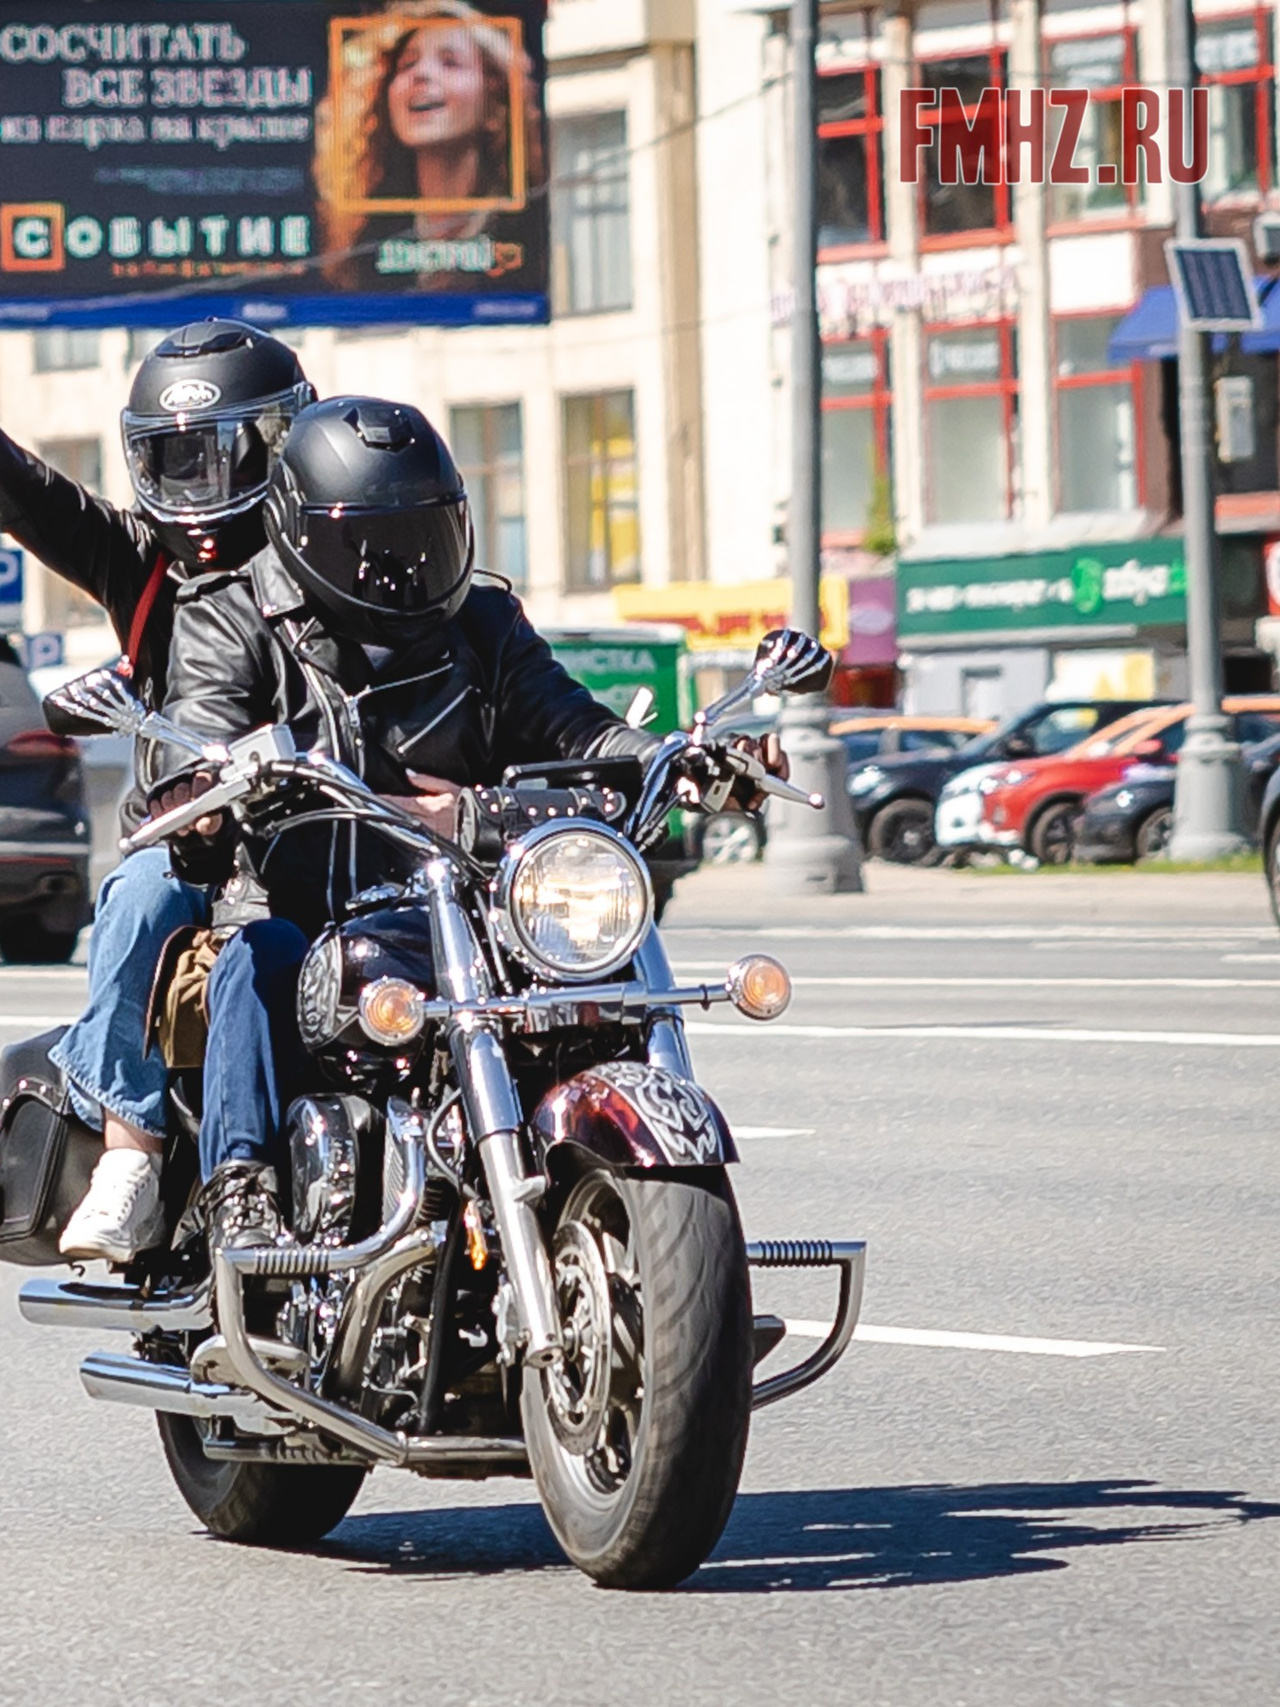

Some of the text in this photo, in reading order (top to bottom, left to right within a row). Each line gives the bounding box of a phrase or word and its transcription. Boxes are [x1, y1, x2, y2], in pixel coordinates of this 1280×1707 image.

[0, 23, 246, 62] СОСЧИТАТЬ
[62, 67, 313, 108] ВСЕ ЗВЕЗДЫ
[13, 214, 311, 258] СОБЫТИЕ
